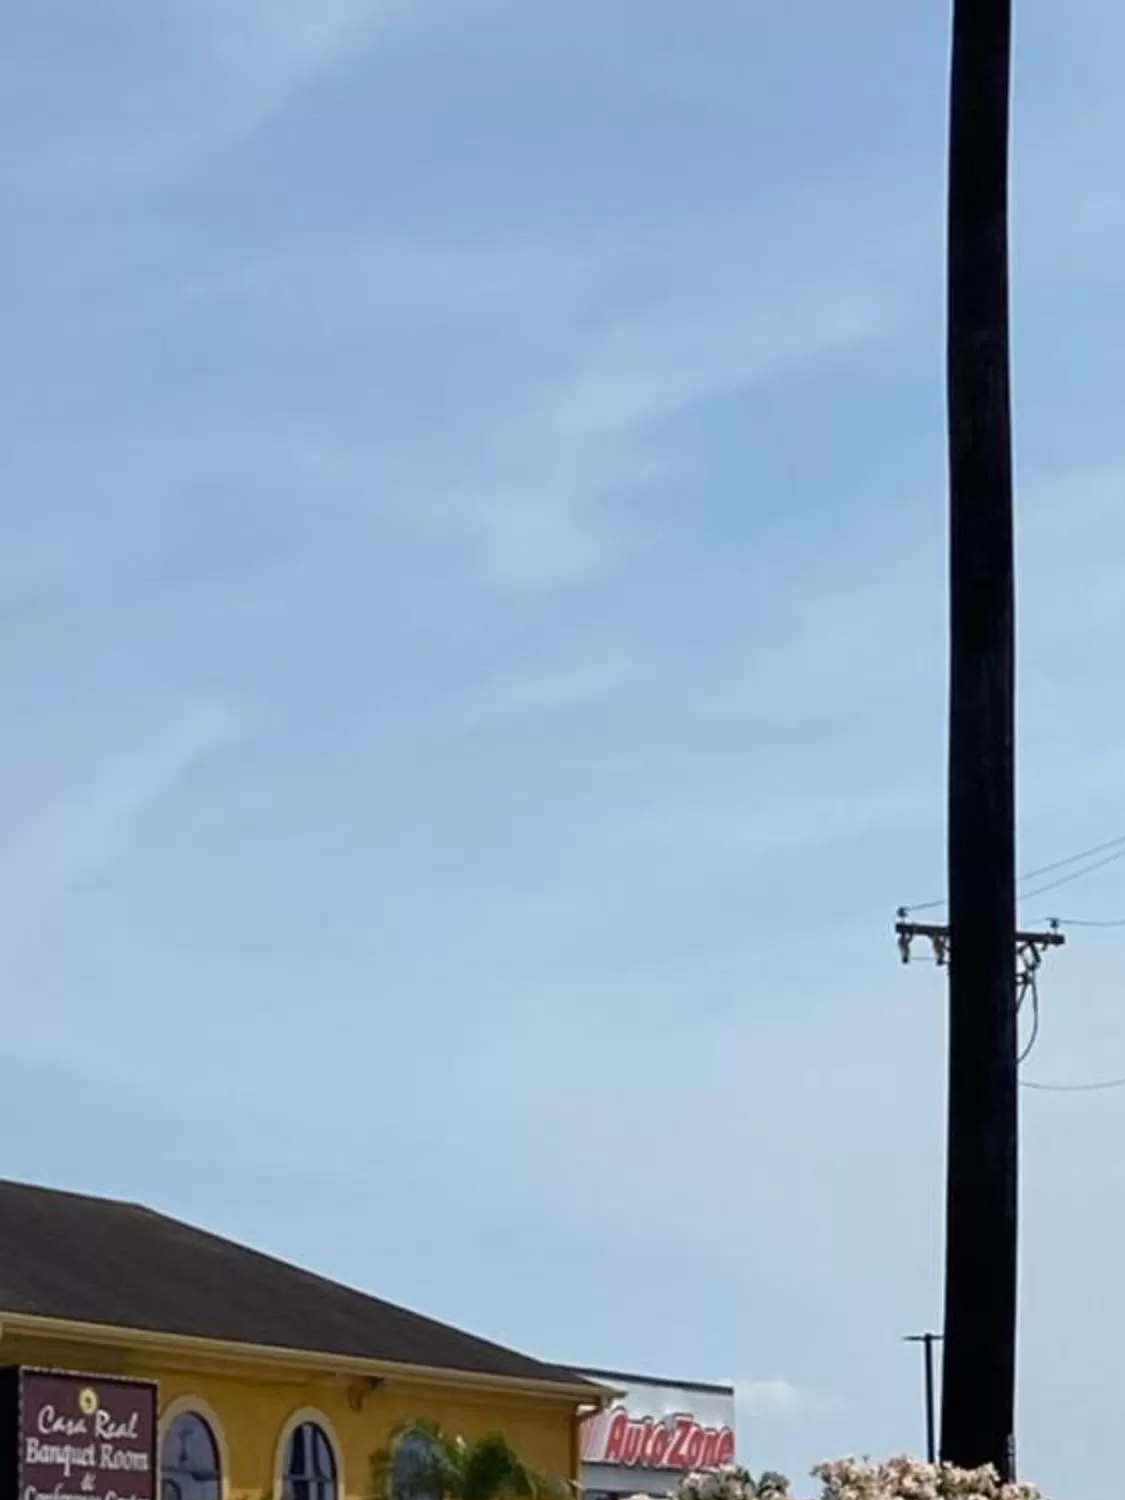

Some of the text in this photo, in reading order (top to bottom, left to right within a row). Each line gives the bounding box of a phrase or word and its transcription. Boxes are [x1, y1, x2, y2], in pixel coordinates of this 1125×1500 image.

[37, 1404, 139, 1440] Casa Real
[604, 1409, 736, 1469] AutoZone
[25, 1437, 149, 1478] Banquet Room
[80, 1472, 97, 1491] &
